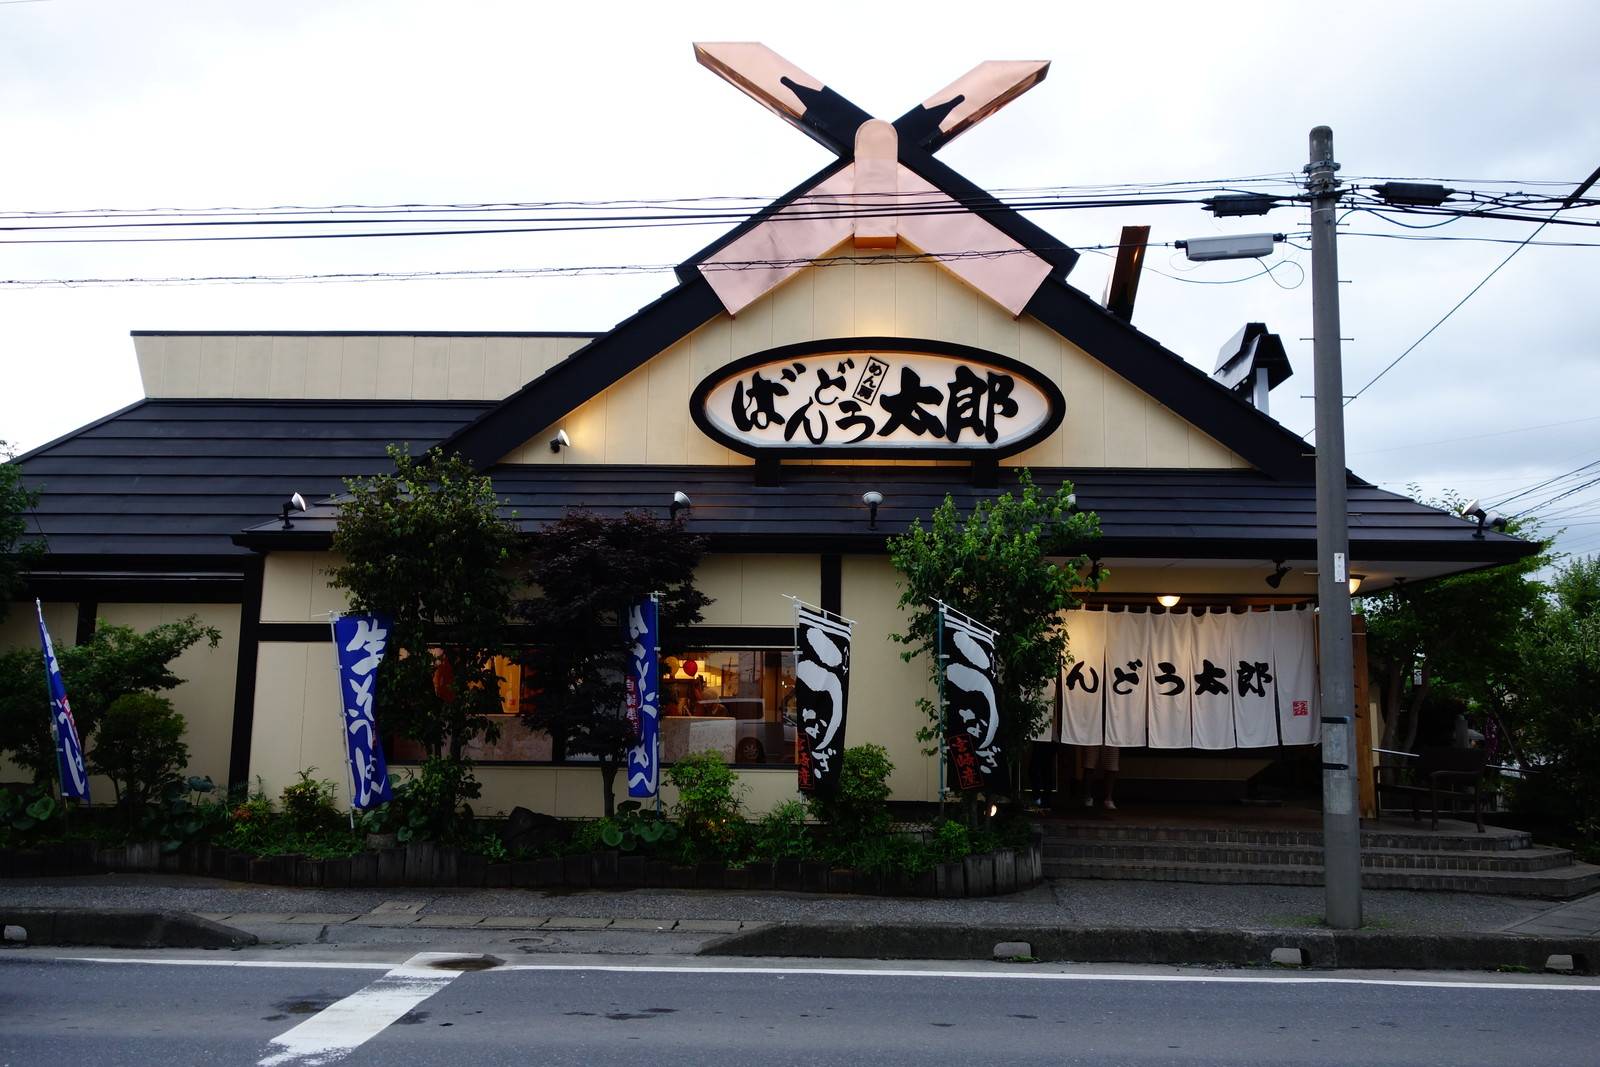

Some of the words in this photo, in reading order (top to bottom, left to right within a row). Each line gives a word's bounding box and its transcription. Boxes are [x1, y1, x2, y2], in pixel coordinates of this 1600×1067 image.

[731, 358, 1019, 444] ばんどう太郎
